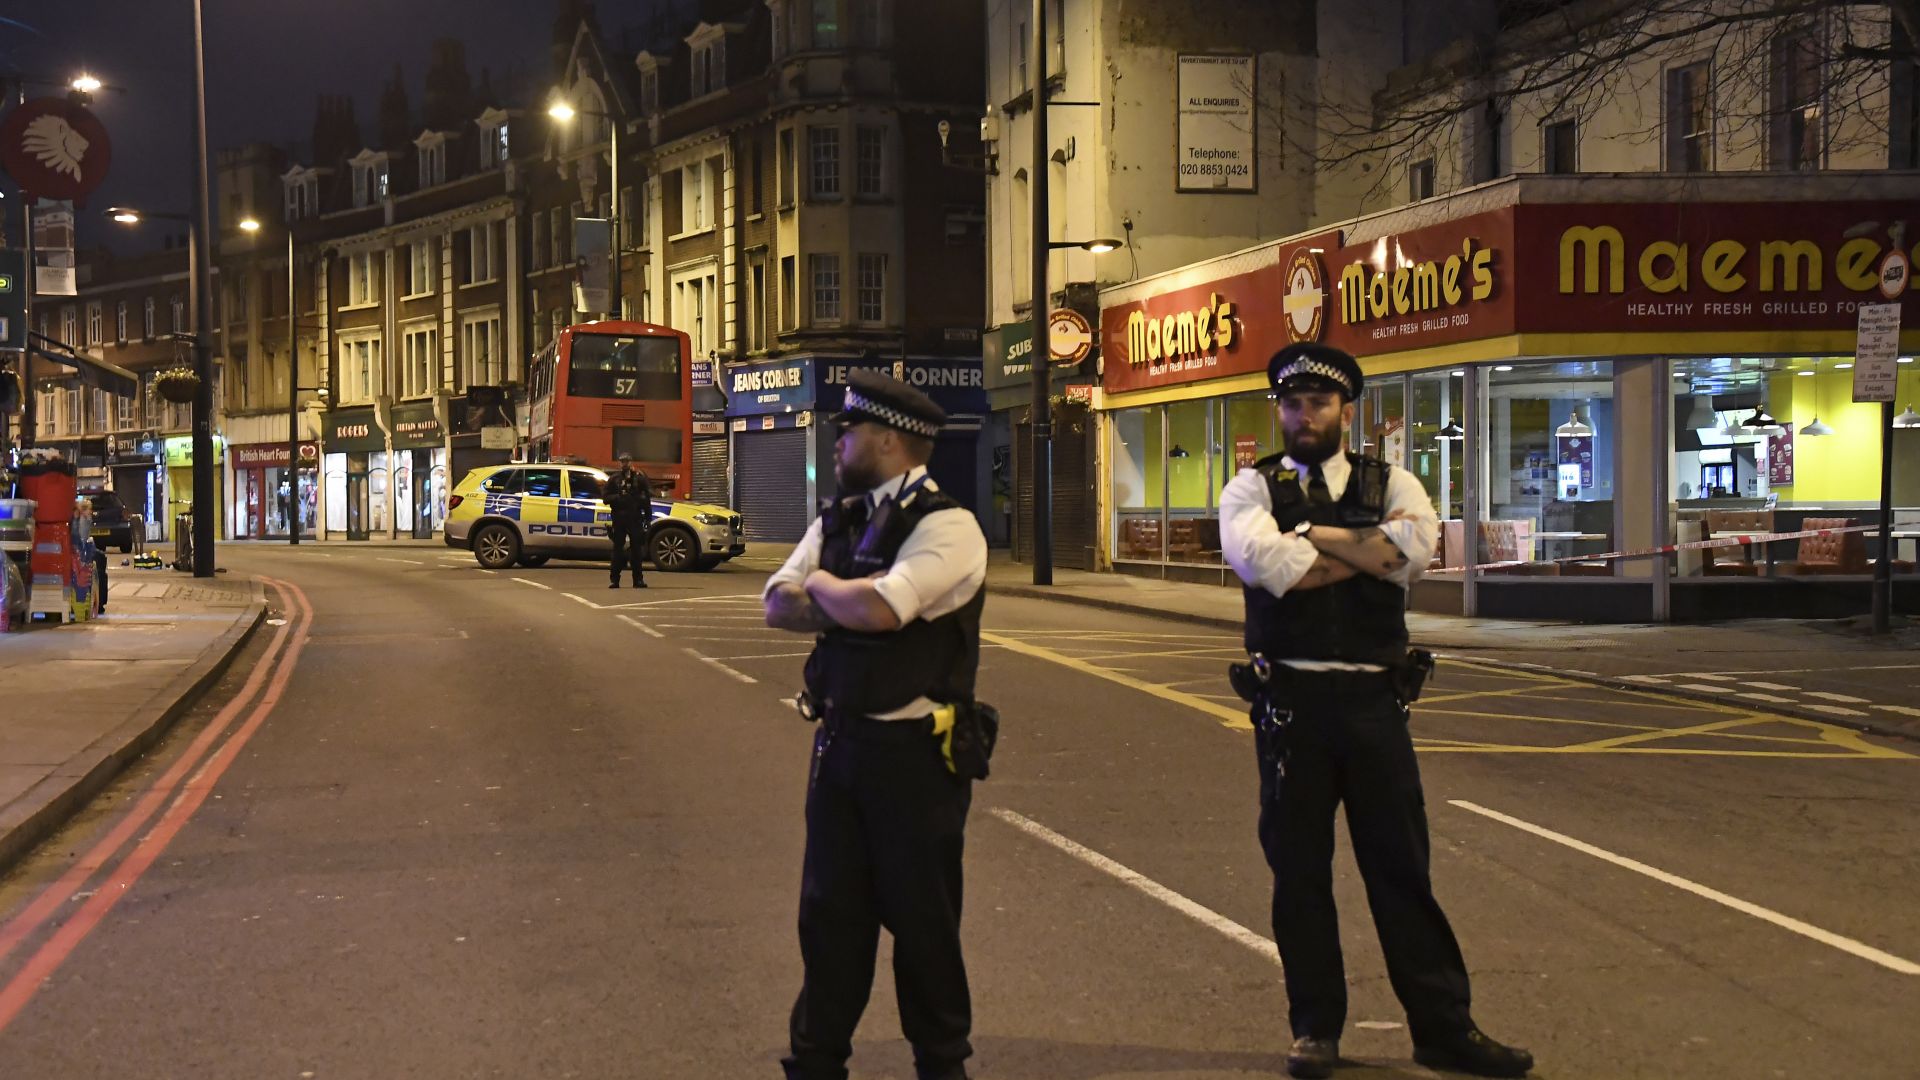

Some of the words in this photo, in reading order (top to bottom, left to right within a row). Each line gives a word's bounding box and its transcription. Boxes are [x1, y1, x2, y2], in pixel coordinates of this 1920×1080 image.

[1189, 98, 1201, 106] ALL
[1203, 98, 1240, 107] ENQUIRIES
[1188, 147, 1240, 161] Telephone:
[1181, 164, 1198, 175] 020
[1200, 164, 1223, 175] 8853
[1225, 164, 1248, 176] 0424
[1627, 303, 1694, 316] HEALTHY
[1704, 303, 1752, 316] FRESH
[1763, 303, 1828, 315] GRILLED
[1837, 302, 1876, 315] FO
[1372, 325, 1398, 340] HEALTHY
[1400, 322, 1419, 336] FRESH
[1422, 317, 1449, 331] GRILLED
[1451, 313, 1469, 327] FOOD
[1007, 338, 1033, 360] SUB
[691, 363, 707, 371] ANS
[691, 371, 712, 379] RNER
[732, 371, 762, 393] JEANS
[762, 367, 801, 389] CORNER
[904, 367, 983, 387] ORNER
[615, 378, 636, 395] 57
[336, 423, 369, 438] ROGERS
[239, 449, 259, 462] British
[258, 448, 275, 461] Heart
[275, 448, 290, 460] Foun
[528, 524, 608, 537] POLIC
